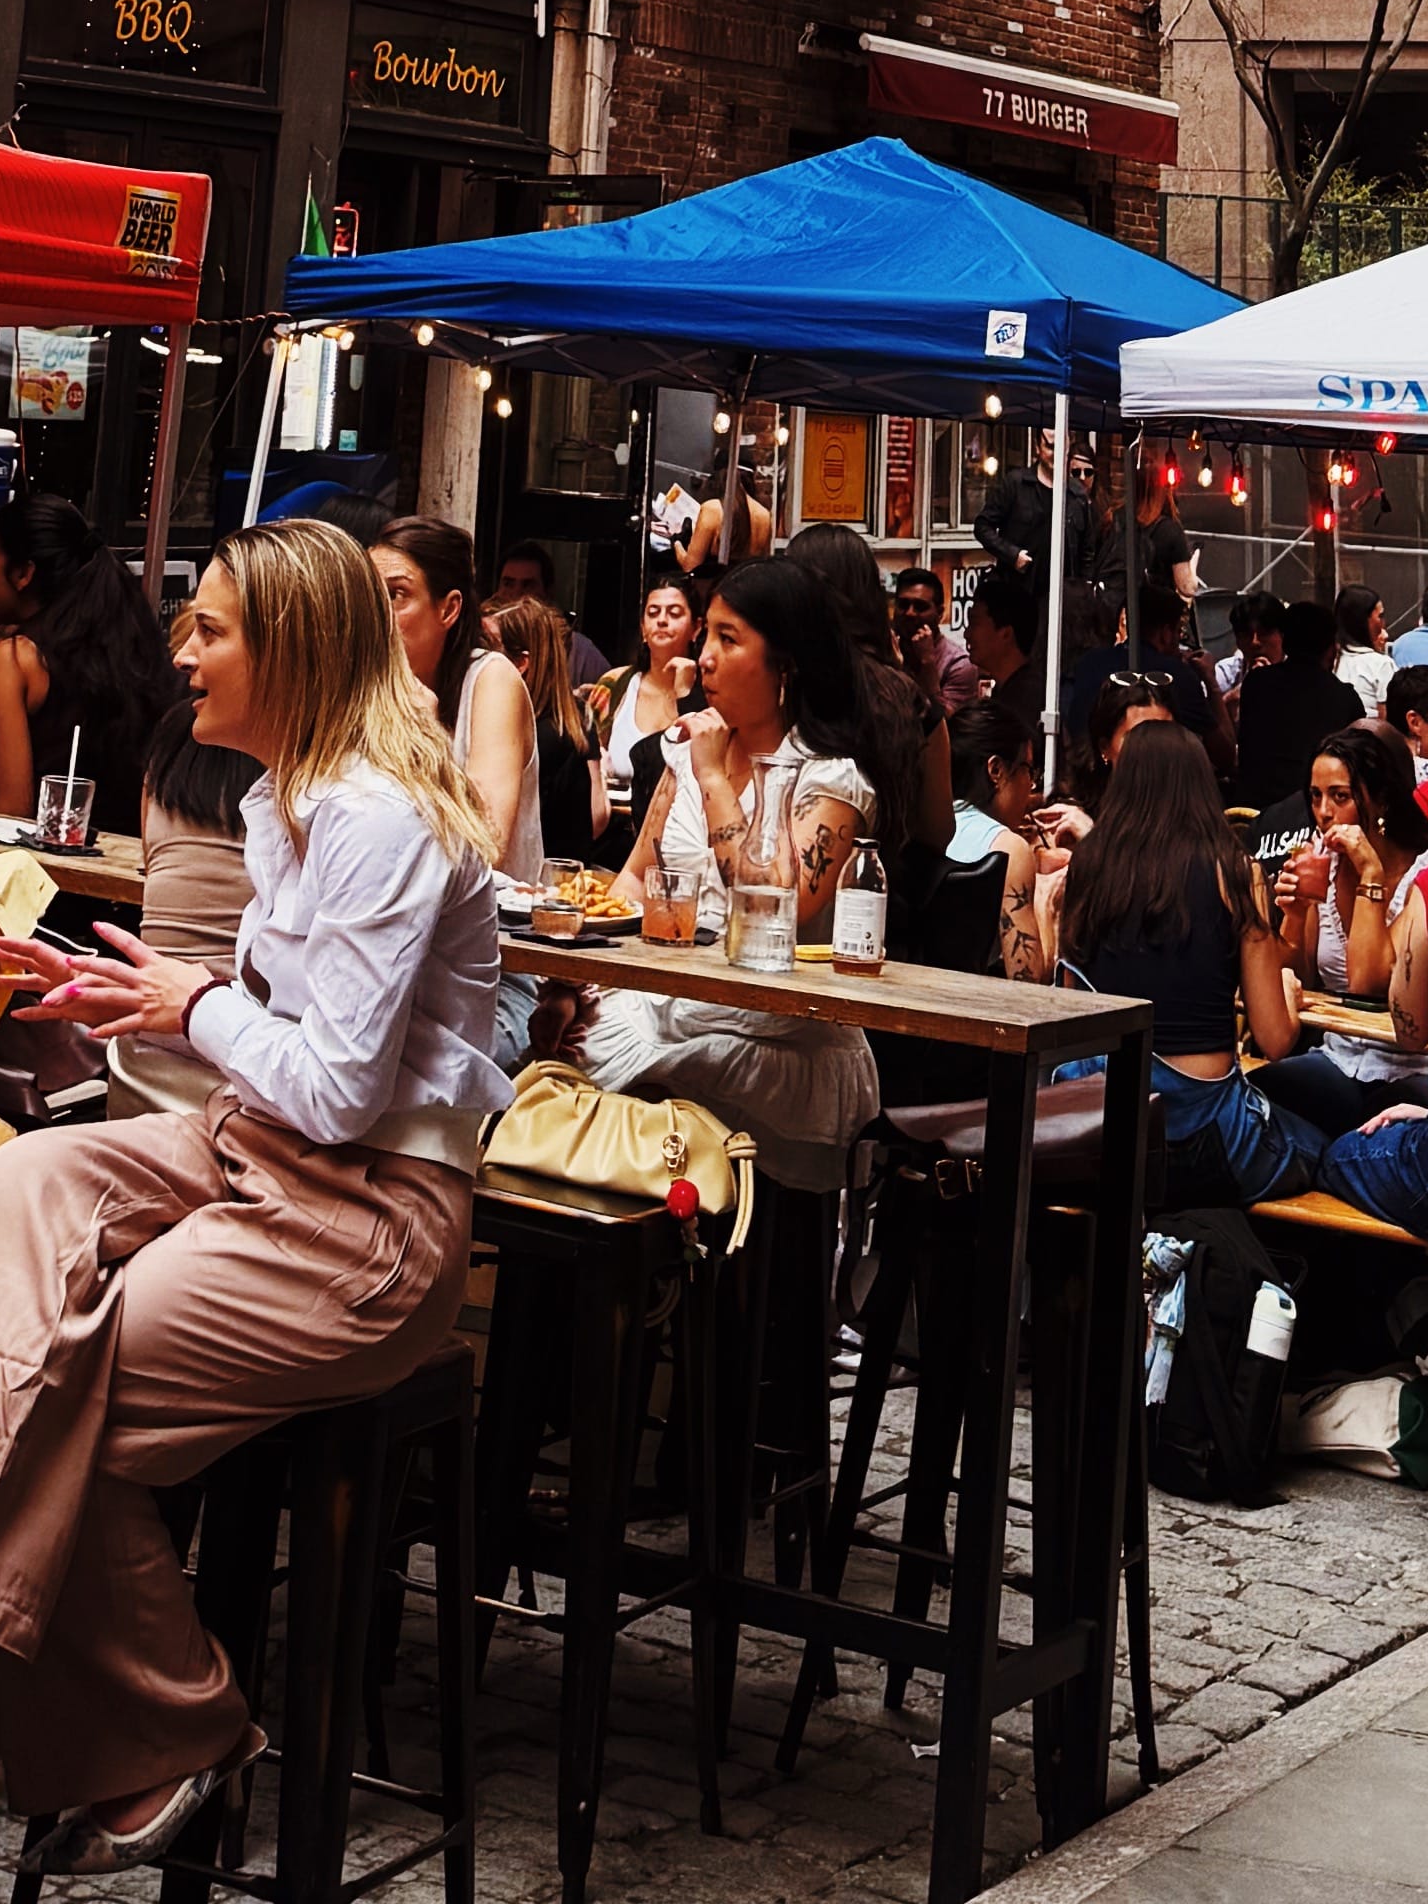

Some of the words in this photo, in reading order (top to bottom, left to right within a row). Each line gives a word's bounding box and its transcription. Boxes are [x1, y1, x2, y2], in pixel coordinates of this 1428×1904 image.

[371, 37, 505, 101] Bourbon
[982, 89, 1006, 118] 77
[1010, 95, 1090, 135] BURGER
[129, 199, 177, 224] WORLD
[119, 218, 173, 254] BEER
